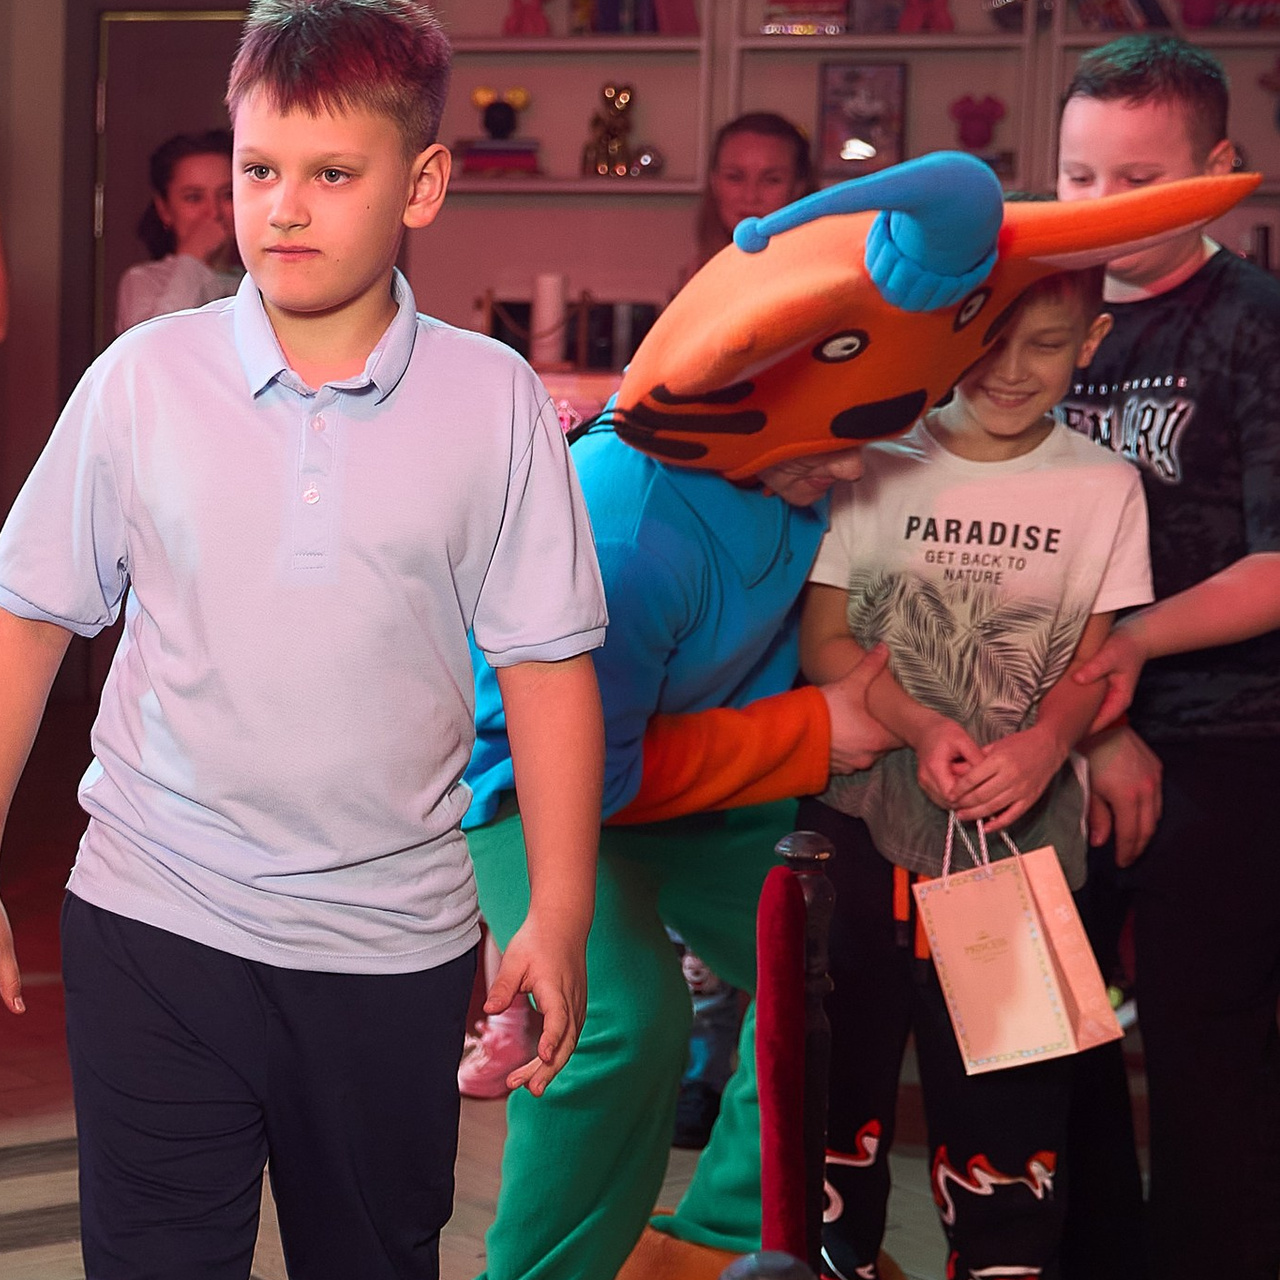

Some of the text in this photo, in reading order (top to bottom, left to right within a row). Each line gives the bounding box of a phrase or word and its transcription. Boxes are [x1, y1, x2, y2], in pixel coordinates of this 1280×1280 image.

[905, 516, 1061, 554] PARADISE
[924, 550, 1027, 571] GET BACK TO
[943, 569, 1004, 586] NATURE
